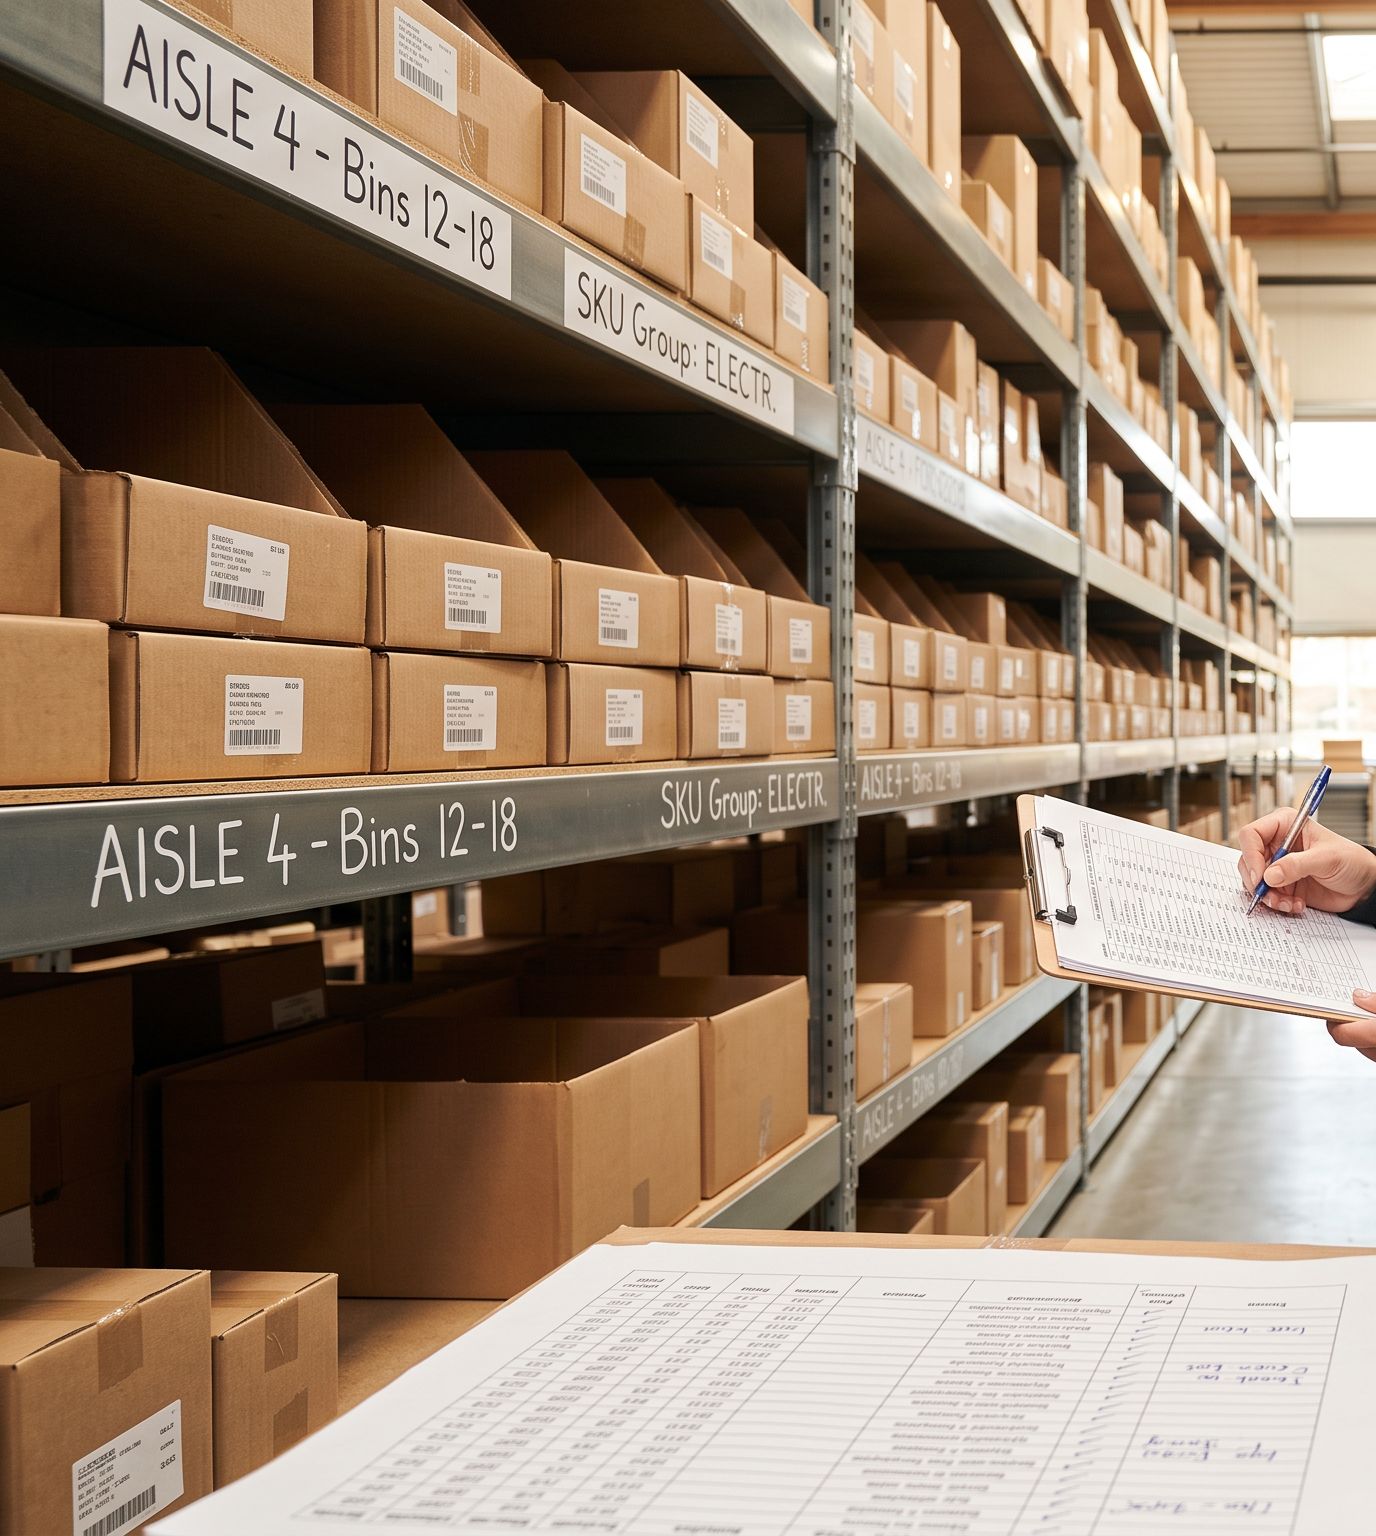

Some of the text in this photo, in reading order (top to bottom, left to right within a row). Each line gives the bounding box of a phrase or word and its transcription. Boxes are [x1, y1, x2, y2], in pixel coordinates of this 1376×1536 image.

[123, 23, 497, 271] AISLE 4 - Bins 12-18
[577, 272, 777, 414] SKU Group: ELECTR.
[660, 770, 828, 829] SKU Group: ELECTR.
[860, 764, 894, 801] AISLE
[91, 796, 518, 908] AISLE 4 - Bins 12-18
[862, 1093, 894, 1149] AISLE
